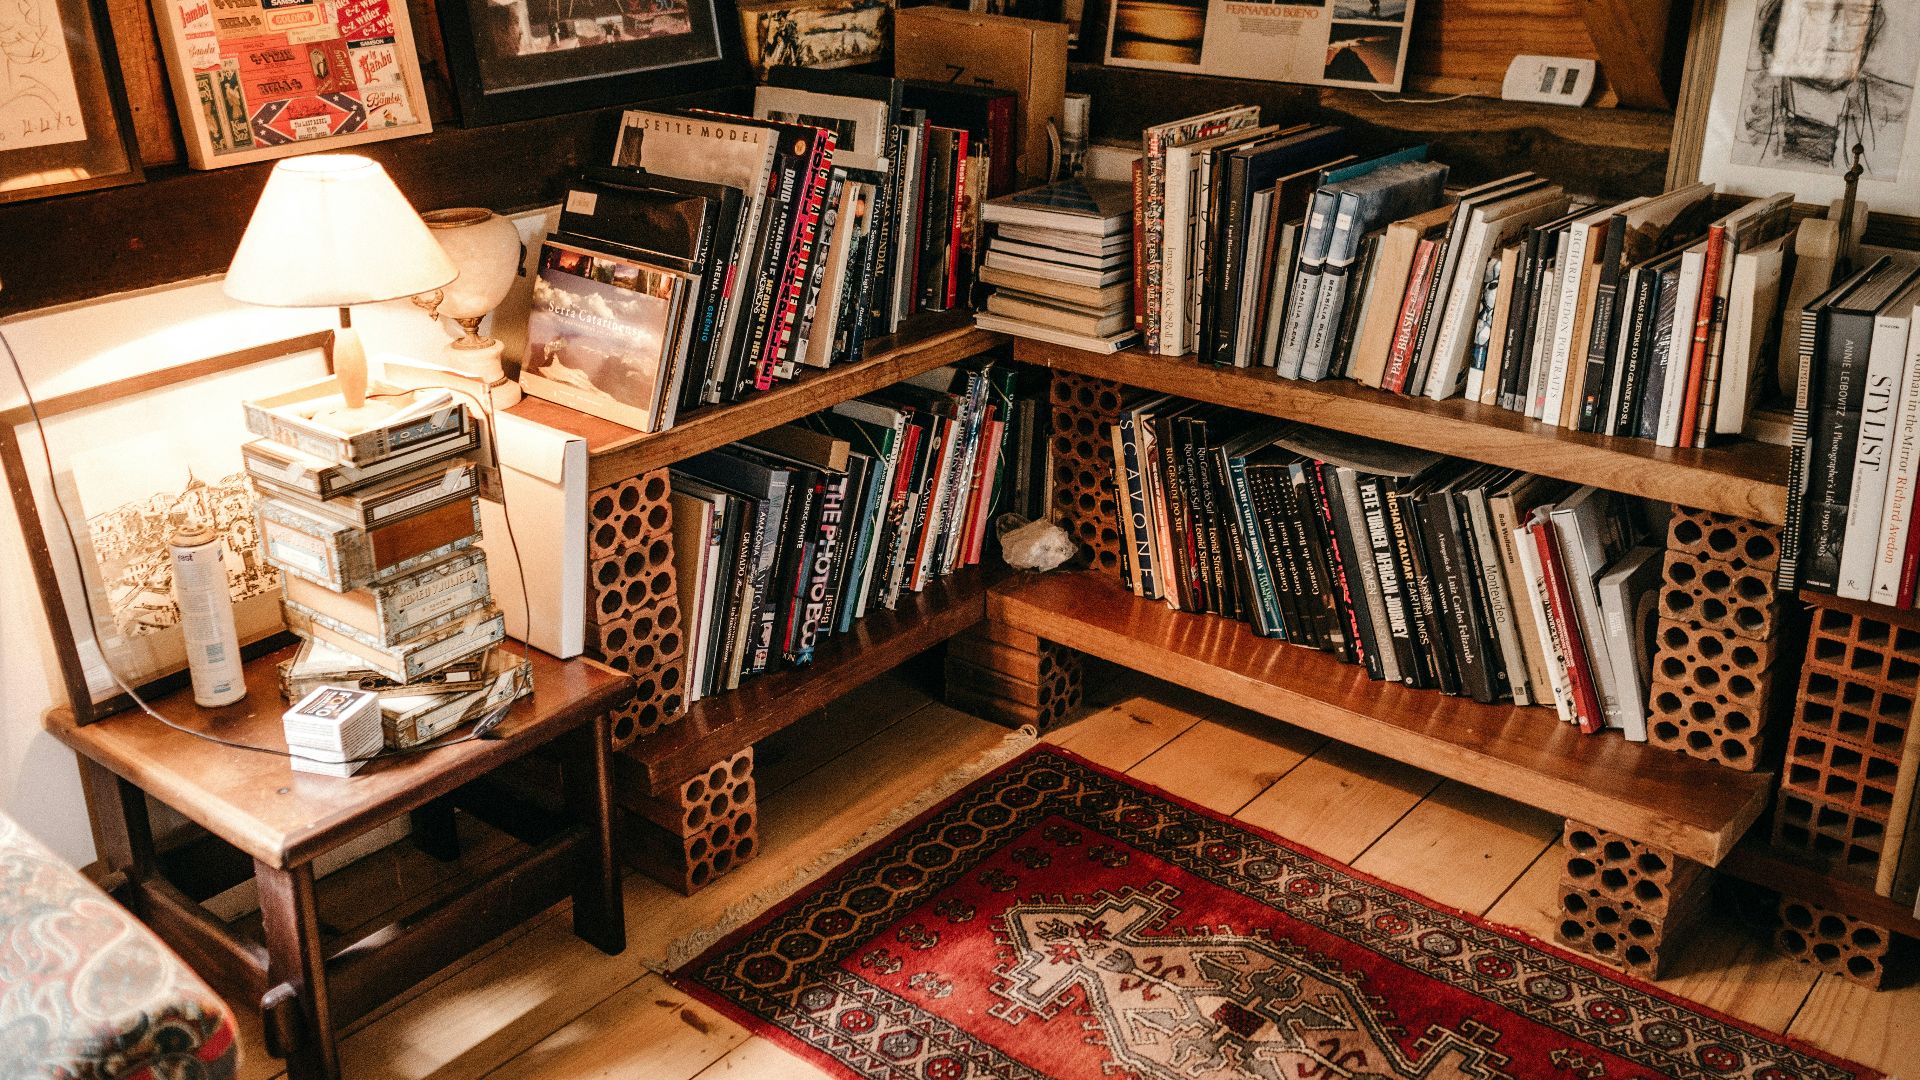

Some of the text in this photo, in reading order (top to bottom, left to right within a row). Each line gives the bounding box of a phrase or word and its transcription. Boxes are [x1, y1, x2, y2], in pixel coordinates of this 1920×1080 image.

[1226, 4, 1319, 19] FERNANDO BUENO
[626, 116, 759, 144] LISETTE MODEL
[1149, 137, 1158, 156] LIFE
[777, 167, 797, 204] DAVID
[800, 135, 827, 216] HOTEL
[896, 144, 908, 216] PORTO ALEGRE
[1134, 169, 1142, 204] HAVANA
[952, 158, 967, 229] flesh and spirit
[1134, 206, 1143, 225] VIEJA
[864, 228, 878, 261] Seasons
[1164, 246, 1176, 277] Images
[1564, 228, 1584, 284] RICHARD
[708, 257, 725, 292] ARENA
[858, 272, 871, 295] Light
[864, 261, 872, 272] of
[548, 299, 576, 319] Serra
[707, 292, 717, 304] DO
[751, 269, 768, 314] MIGRATIONS
[1164, 287, 1175, 308] Rock
[1558, 286, 1576, 334] AVEDON
[1163, 321, 1173, 338] Roll
[1288, 320, 1299, 347] PLENA
[1312, 321, 1325, 350] PLENA
[1390, 307, 1415, 377] PAU-BRASIL
[1547, 336, 1568, 399] PORTRAITS
[1620, 281, 1649, 426] ANTIGAS FAZENDAS DO RIO GRANDE DO SUL
[1860, 373, 1892, 471] STYLIST
[1906, 399, 1917, 411] in
[1903, 414, 1915, 432] the
[1196, 445, 1208, 460] Rio
[1815, 338, 1854, 557] ANNIE LEIBOVITZ A Photographer's Life 1990 2005
[1897, 433, 1913, 473] Mirror
[1164, 446, 1182, 531] RIO GRANDE DO SUL
[1199, 459, 1211, 489] Grande
[1235, 475, 1248, 503] HENRI
[916, 476, 934, 529] CAMERA
[1118, 417, 1155, 579] SCAVONE
[1203, 488, 1213, 500] do
[1204, 499, 1214, 514] Sul
[1890, 475, 1906, 521] Richard
[793, 486, 817, 549] BOURKE-WHITE
[1182, 442, 1209, 583] Rio Grande do Sul Leonid Streliaev
[1261, 516, 1278, 544] Brasil
[1496, 511, 1507, 527] Bob
[752, 509, 767, 557] AMAZÔNIA
[1207, 526, 1219, 553] Leonid
[1275, 519, 1291, 548] Brasil
[1884, 523, 1899, 564] Avedon
[735, 531, 753, 577] GRAMADO
[1268, 544, 1280, 558] do
[1282, 547, 1293, 560] do
[1293, 518, 1321, 596] Coração do Brasil
[1359, 482, 1408, 639] PETE TURNER AFRICAN JOURNEY
[1384, 489, 1430, 645] RICHARD KALVAR EARTHLINGS
[1271, 556, 1291, 593] Coração
[1285, 560, 1305, 596] Coração
[1360, 559, 1378, 595] WOMEN
[1445, 573, 1461, 595] Luiz
[1368, 594, 1385, 626] SUSAN
[1449, 592, 1468, 624] Carlos
[1483, 562, 1510, 624] Montevideo
[1375, 626, 1393, 663] SONTAG
[1455, 622, 1477, 665] Felizardo
